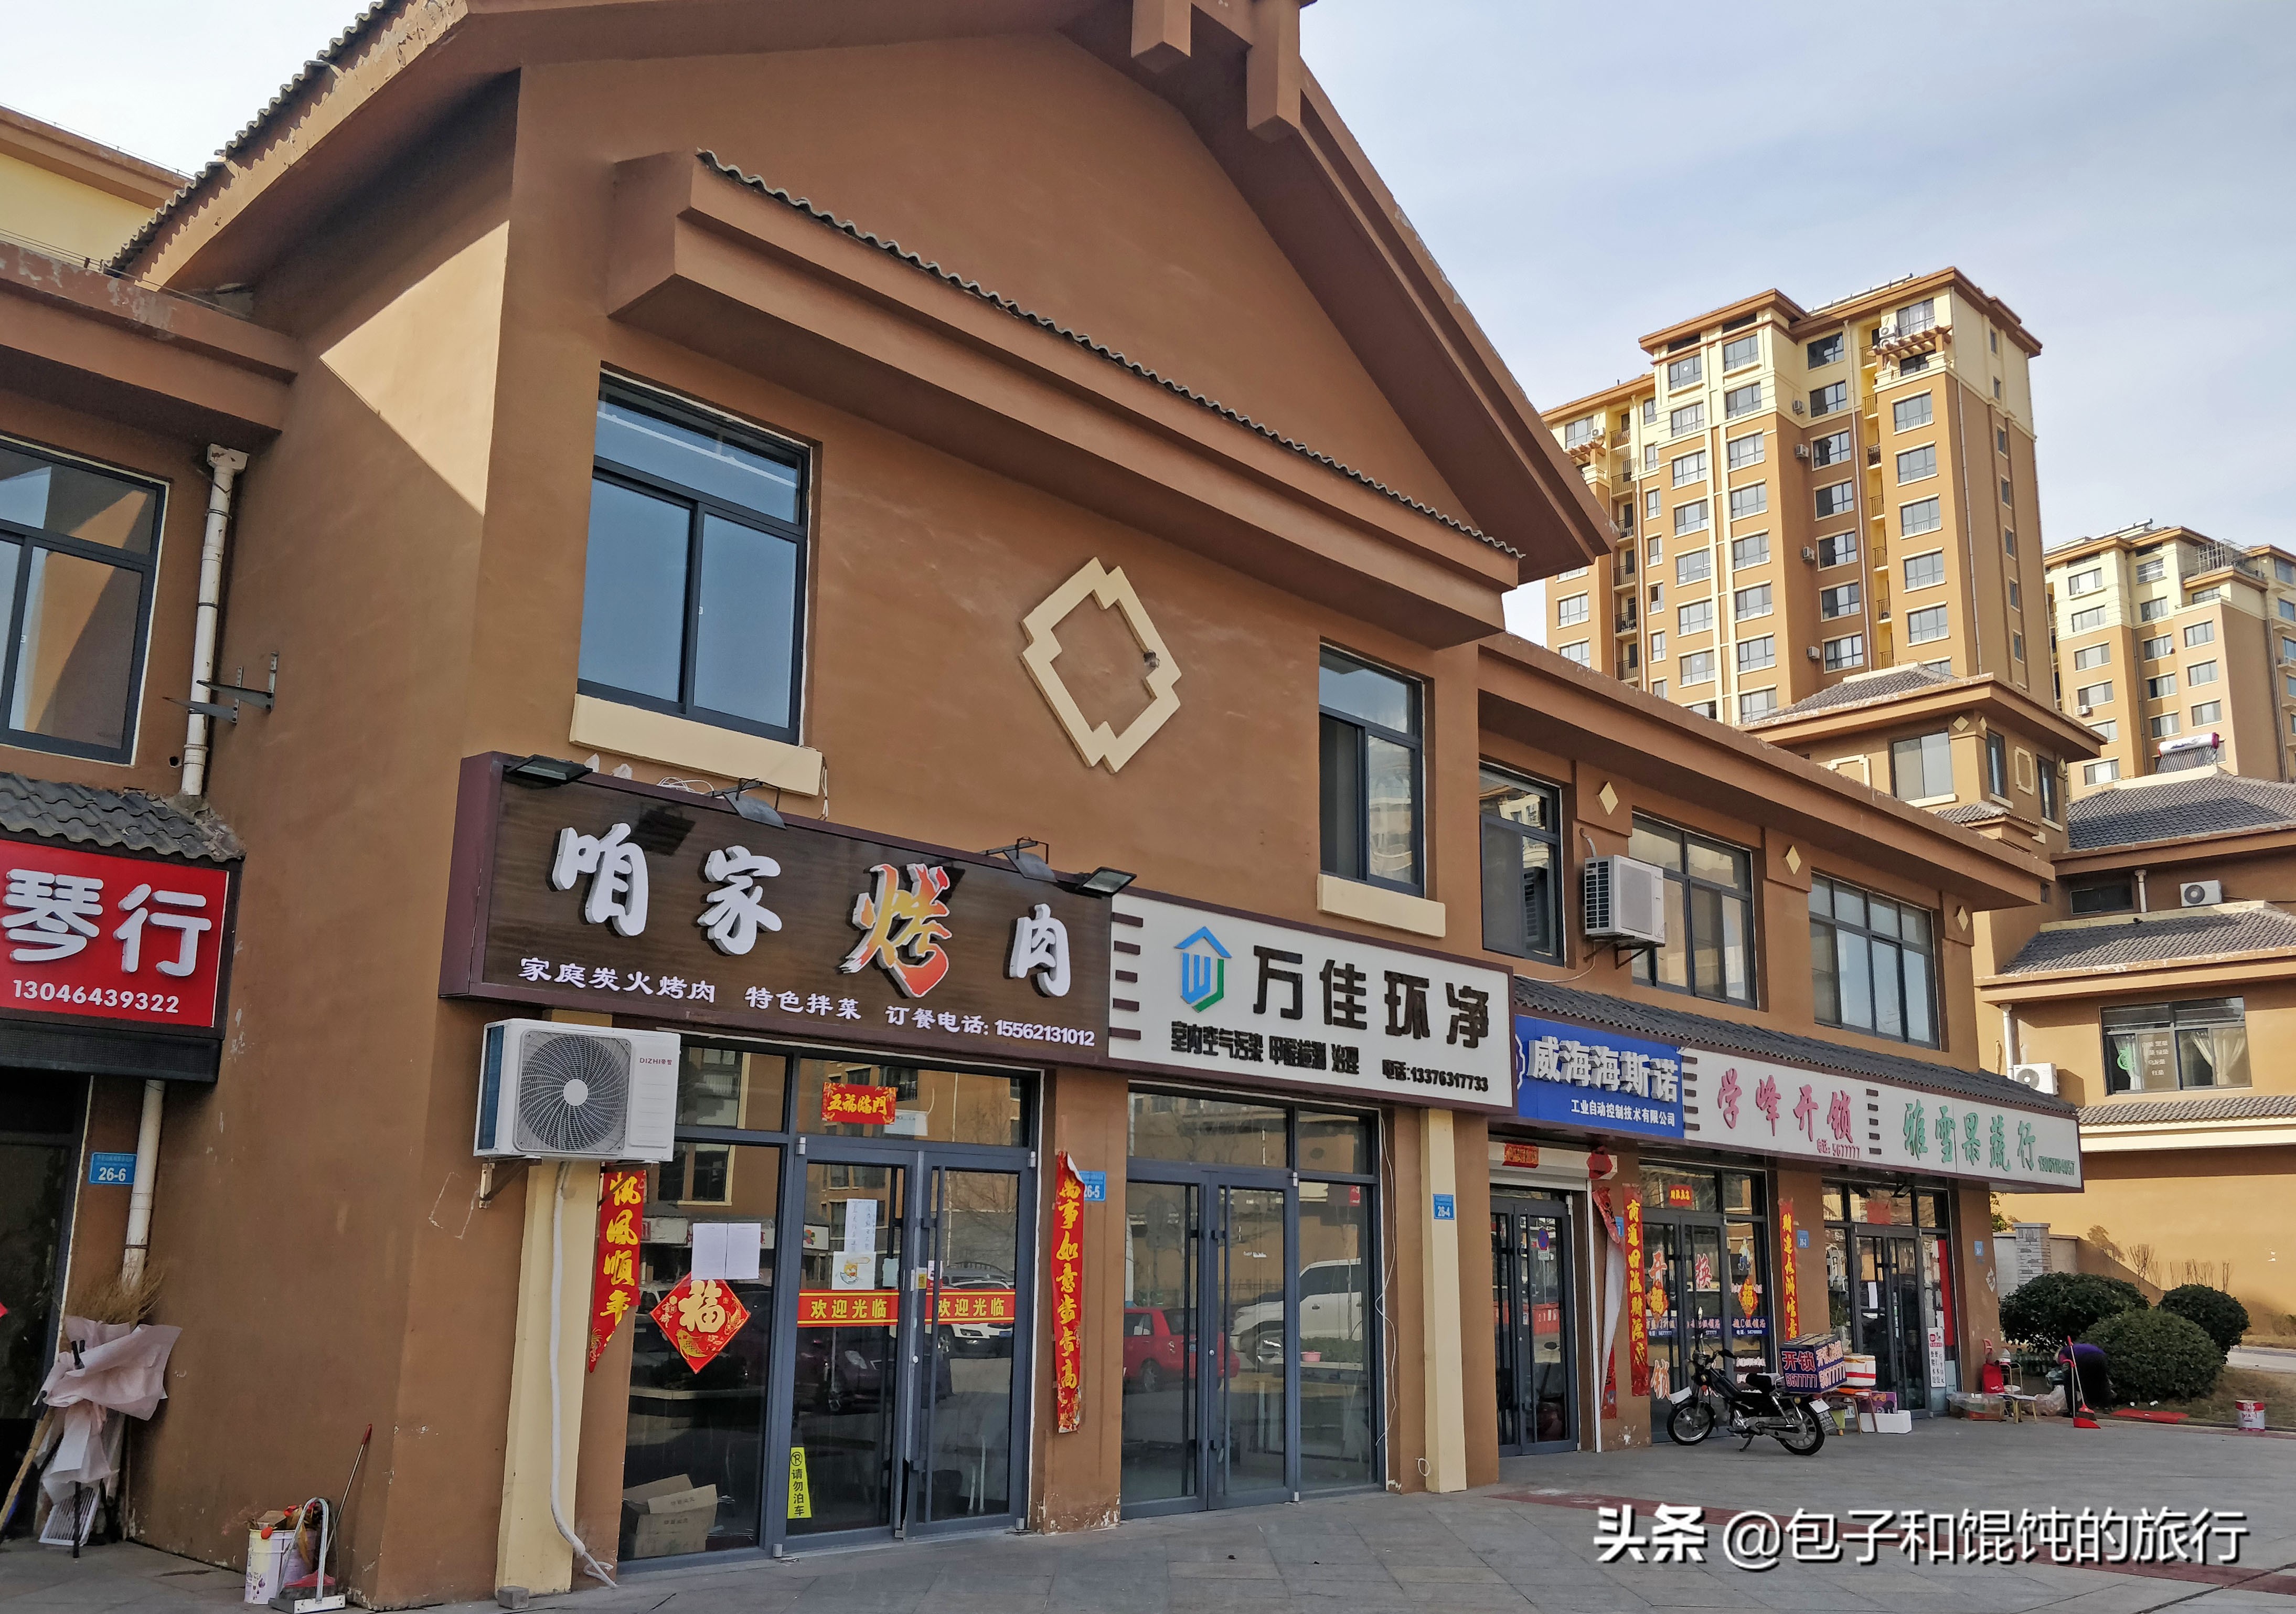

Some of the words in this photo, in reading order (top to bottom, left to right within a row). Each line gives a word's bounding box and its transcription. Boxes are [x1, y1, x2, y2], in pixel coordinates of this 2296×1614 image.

[2, 868, 212, 976] 琴行
[552, 823, 1071, 998] 咱家烤肉
[13, 979, 179, 1014] 13046439322
[518, 957, 716, 1003] 家庭炭火烤肉
[744, 985, 861, 1021] 特色拌菜
[1253, 945, 1490, 1049] 万佳环净
[1527, 1035, 1679, 1103] 威海海斯诺
[1571, 1099, 1675, 1127] 工业自动控制技术有限公司
[98, 1166, 126, 1182] 26-6
[678, 1279, 726, 1333] 福
[810, 1298, 888, 1319] 欢迎光临
[938, 1298, 1005, 1318] 欢迎光临
[1650, 1287, 1664, 1314] 福
[1742, 1282, 1754, 1308] 福
[1781, 1351, 1817, 1372] 开锁
[1785, 1373, 1818, 1388] 5677777
[791, 1468, 805, 1516] 请勿泊车
